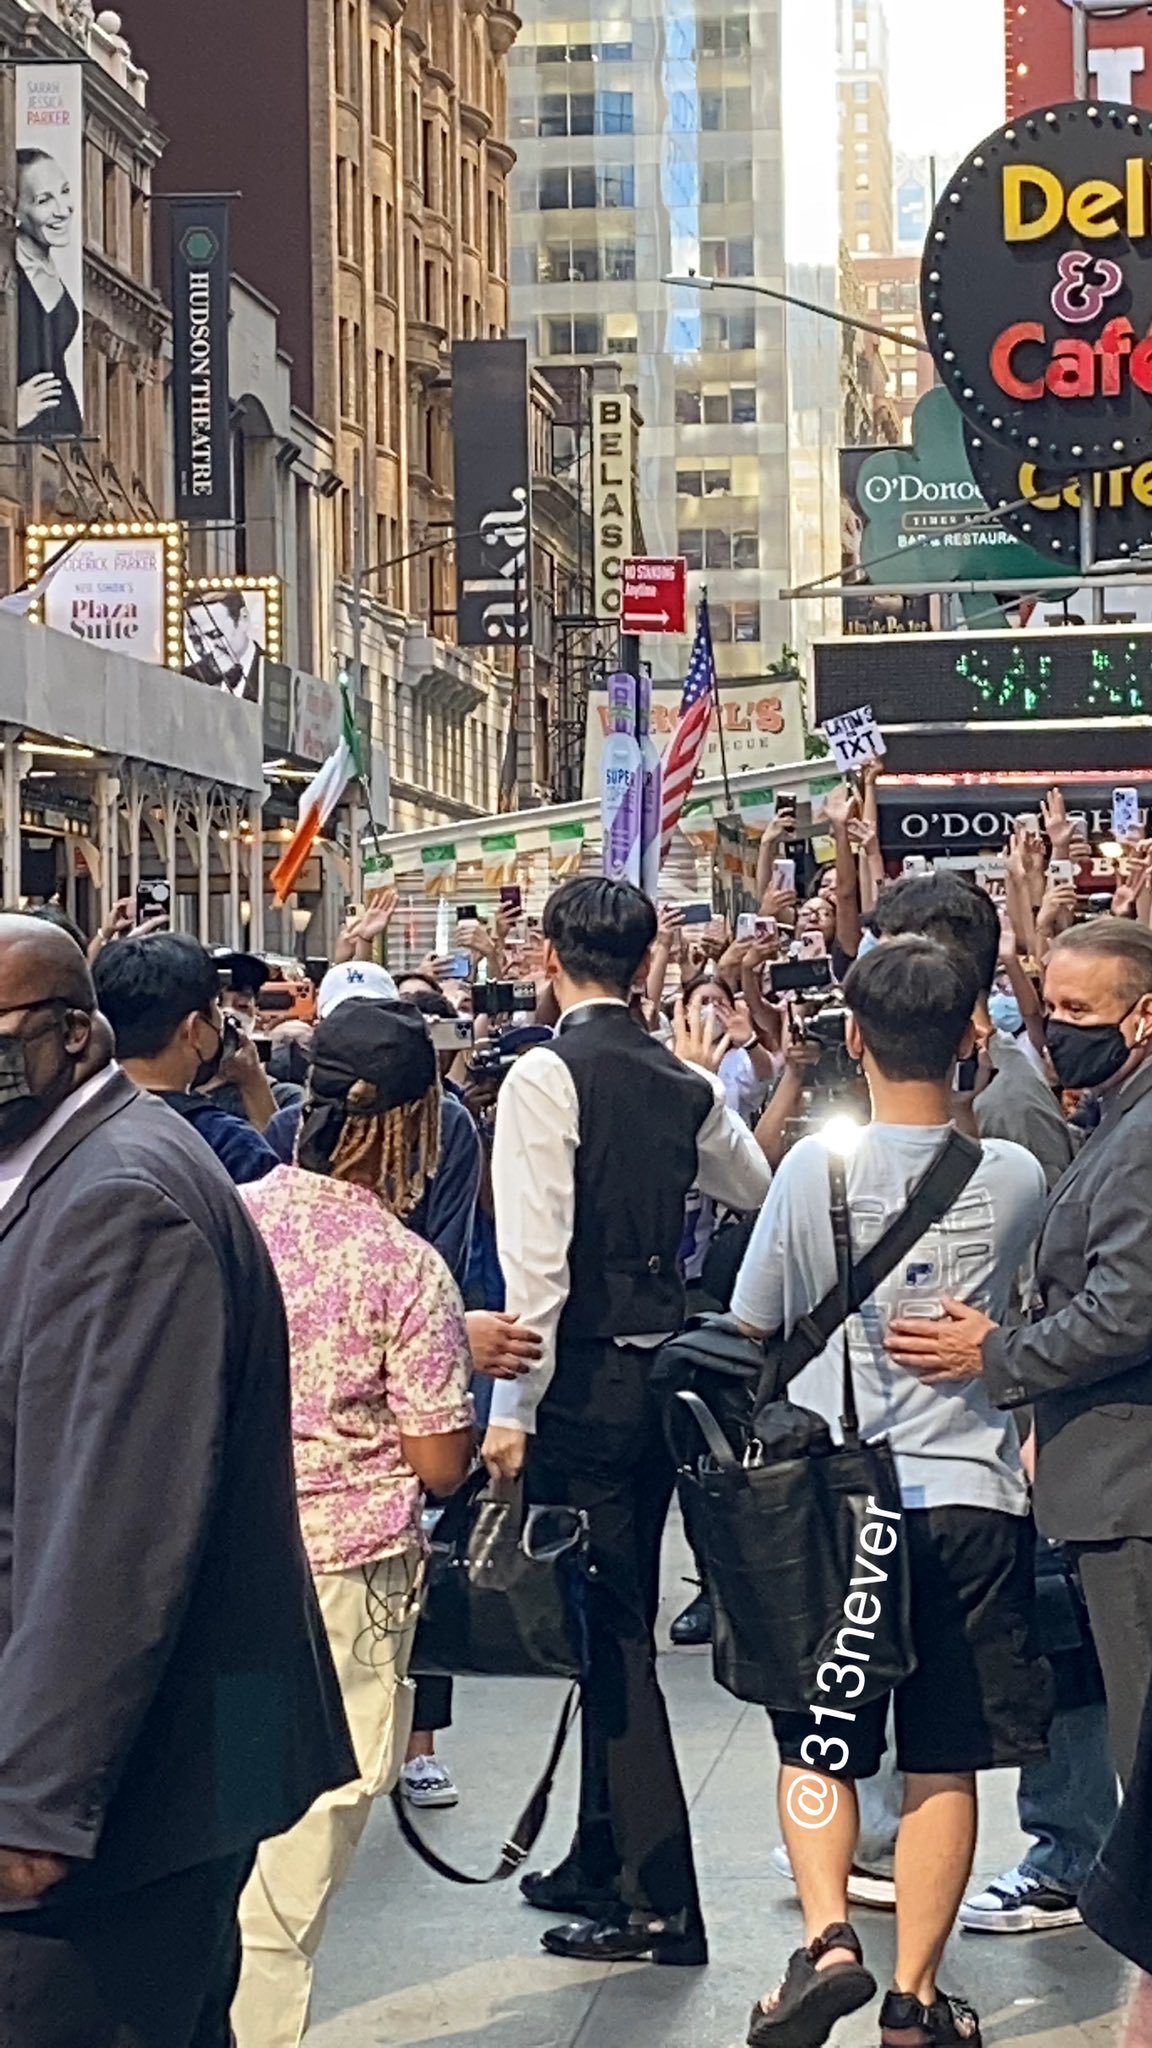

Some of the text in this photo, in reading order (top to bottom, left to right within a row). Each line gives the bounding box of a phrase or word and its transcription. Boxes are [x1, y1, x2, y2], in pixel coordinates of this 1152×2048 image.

[27, 111, 70, 125] PARKER
[1003, 158, 1152, 241] Del
[1051, 250, 1122, 323] &
[189, 271, 213, 495] HUDSON THEATRE
[865, 474, 984, 502] O'Dono
[600, 401, 624, 612] BELASCO
[625, 565, 675, 580] NO STANDING
[72, 600, 137, 618] Plaza
[70, 619, 138, 639] Suite
[836, 731, 878, 759] TXT
